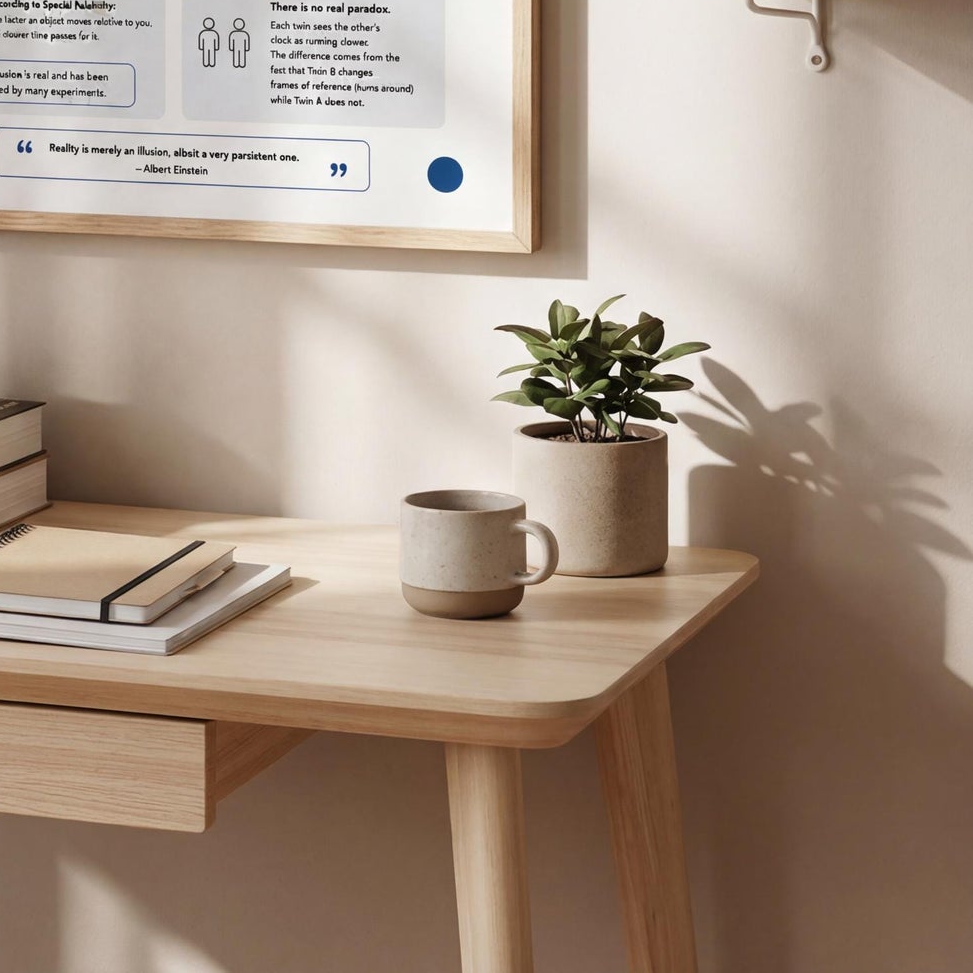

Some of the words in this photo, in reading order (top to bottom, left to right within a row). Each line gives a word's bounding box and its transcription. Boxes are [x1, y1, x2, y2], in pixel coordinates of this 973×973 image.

[81, 144, 89, 153] is
[90, 145, 122, 157] merely
[137, 146, 171, 157] illusion,
[208, 152, 229, 161] very
[142, 164, 171, 173] Albert
[173, 165, 208, 175] Einstein
